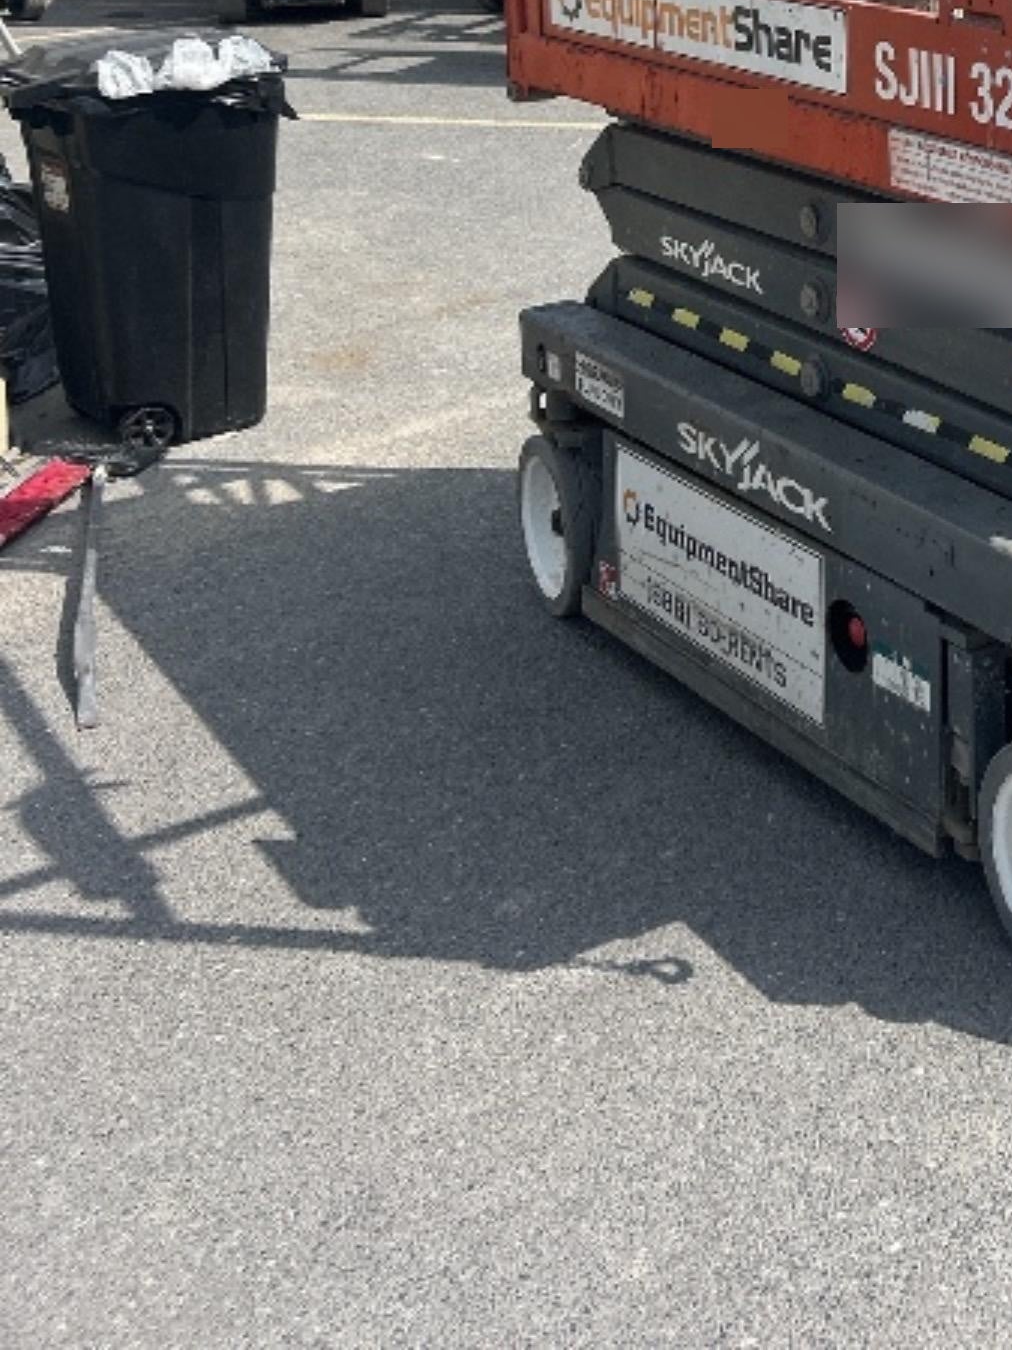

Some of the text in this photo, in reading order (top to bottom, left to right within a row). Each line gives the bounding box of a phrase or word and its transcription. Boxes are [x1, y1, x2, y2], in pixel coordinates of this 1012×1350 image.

[875, 41, 955, 115] SJIII
[660, 236, 764, 295] SKYJACK
[676, 421, 832, 534] SKYJACK
[644, 503, 814, 627] EquipmentShare
